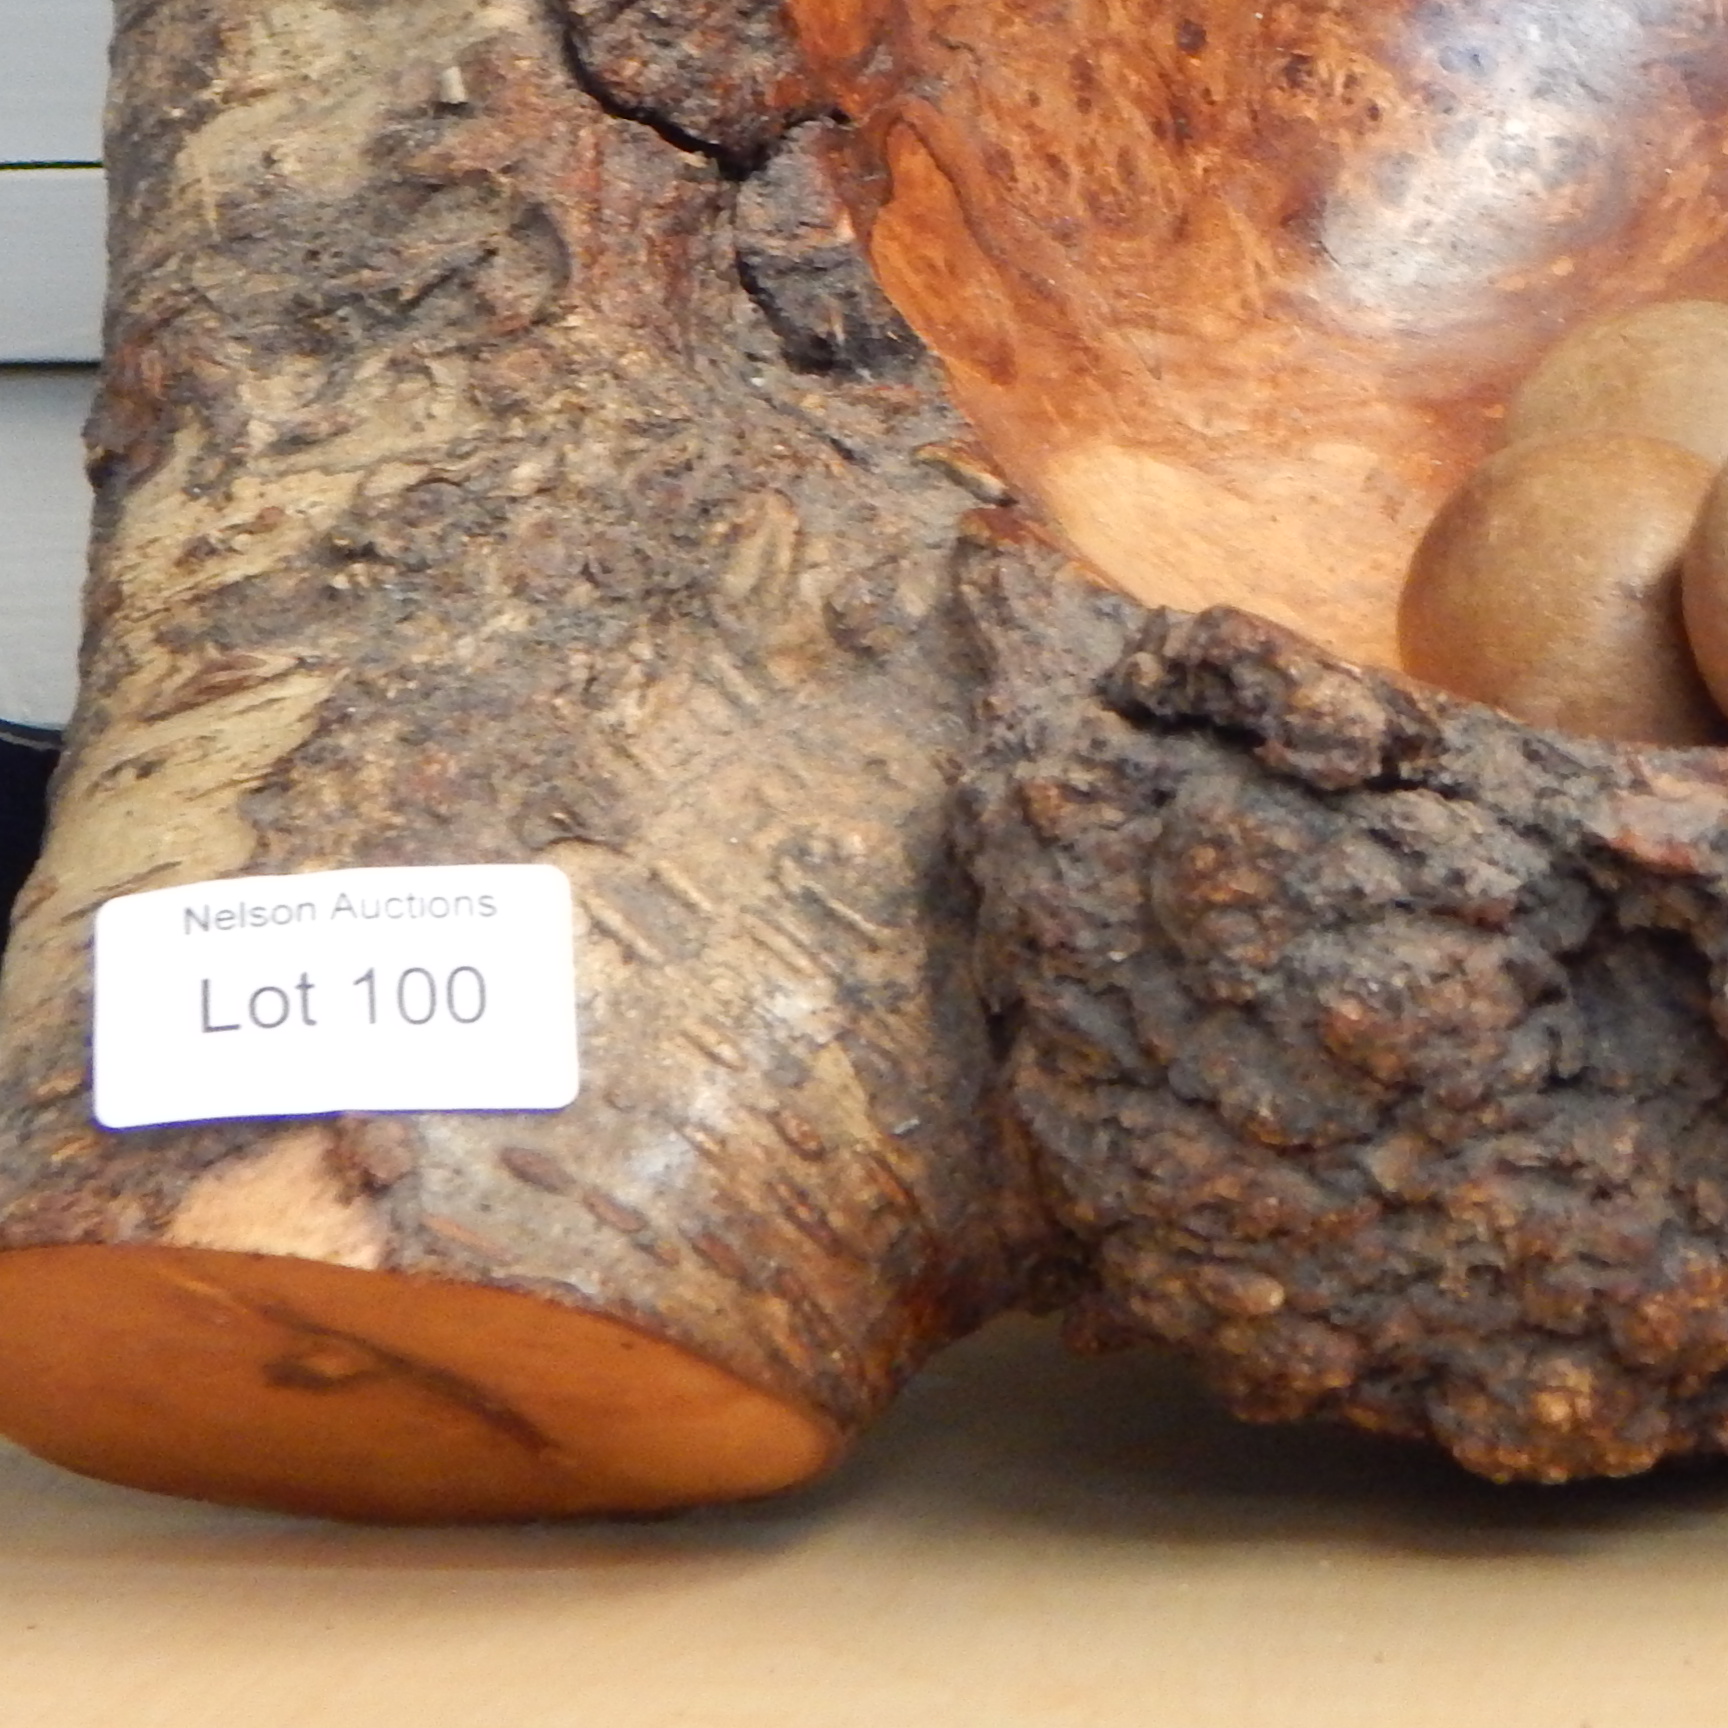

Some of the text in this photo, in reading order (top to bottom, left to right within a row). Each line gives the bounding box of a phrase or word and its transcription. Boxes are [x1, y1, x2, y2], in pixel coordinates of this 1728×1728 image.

[183, 892, 498, 935] Nelson Auctions
[201, 965, 488, 1034] Lot 100
